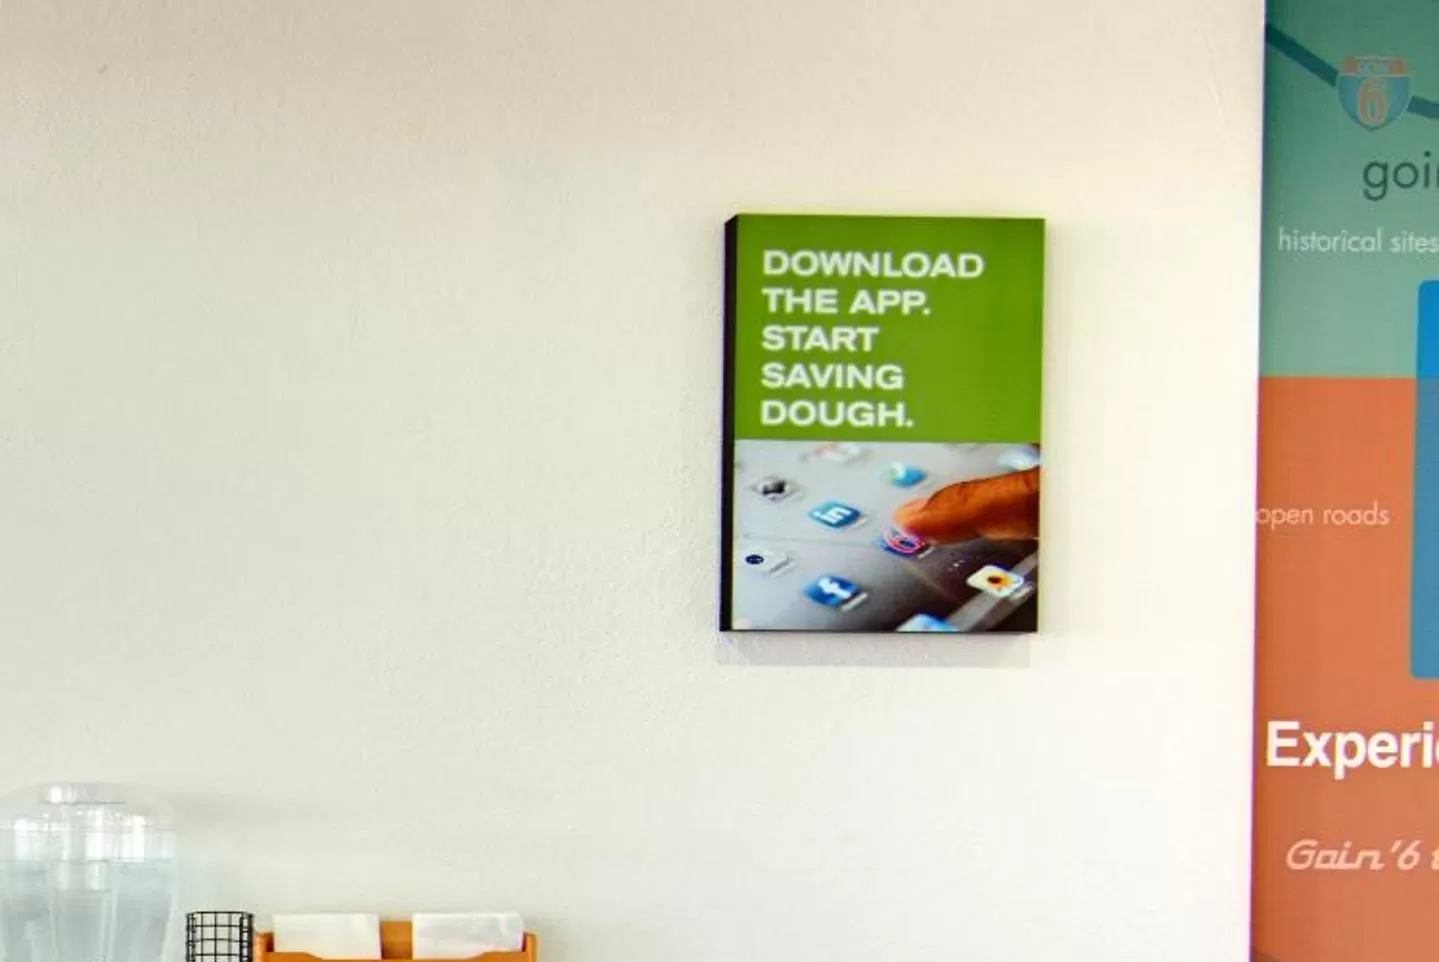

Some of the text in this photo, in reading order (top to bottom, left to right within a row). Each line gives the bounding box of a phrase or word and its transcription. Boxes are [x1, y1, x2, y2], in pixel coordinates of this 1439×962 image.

[1363, 151, 1439, 201] goi
[1278, 227, 1439, 254] historical sites
[763, 249, 985, 279] DOWNLOAD
[762, 287, 931, 316] THE APP.
[761, 325, 880, 352] START
[761, 362, 905, 390] SAVING
[761, 400, 915, 428] DOUGH.
[1257, 499, 1390, 531] open roads
[1266, 720, 1439, 780] Experi
